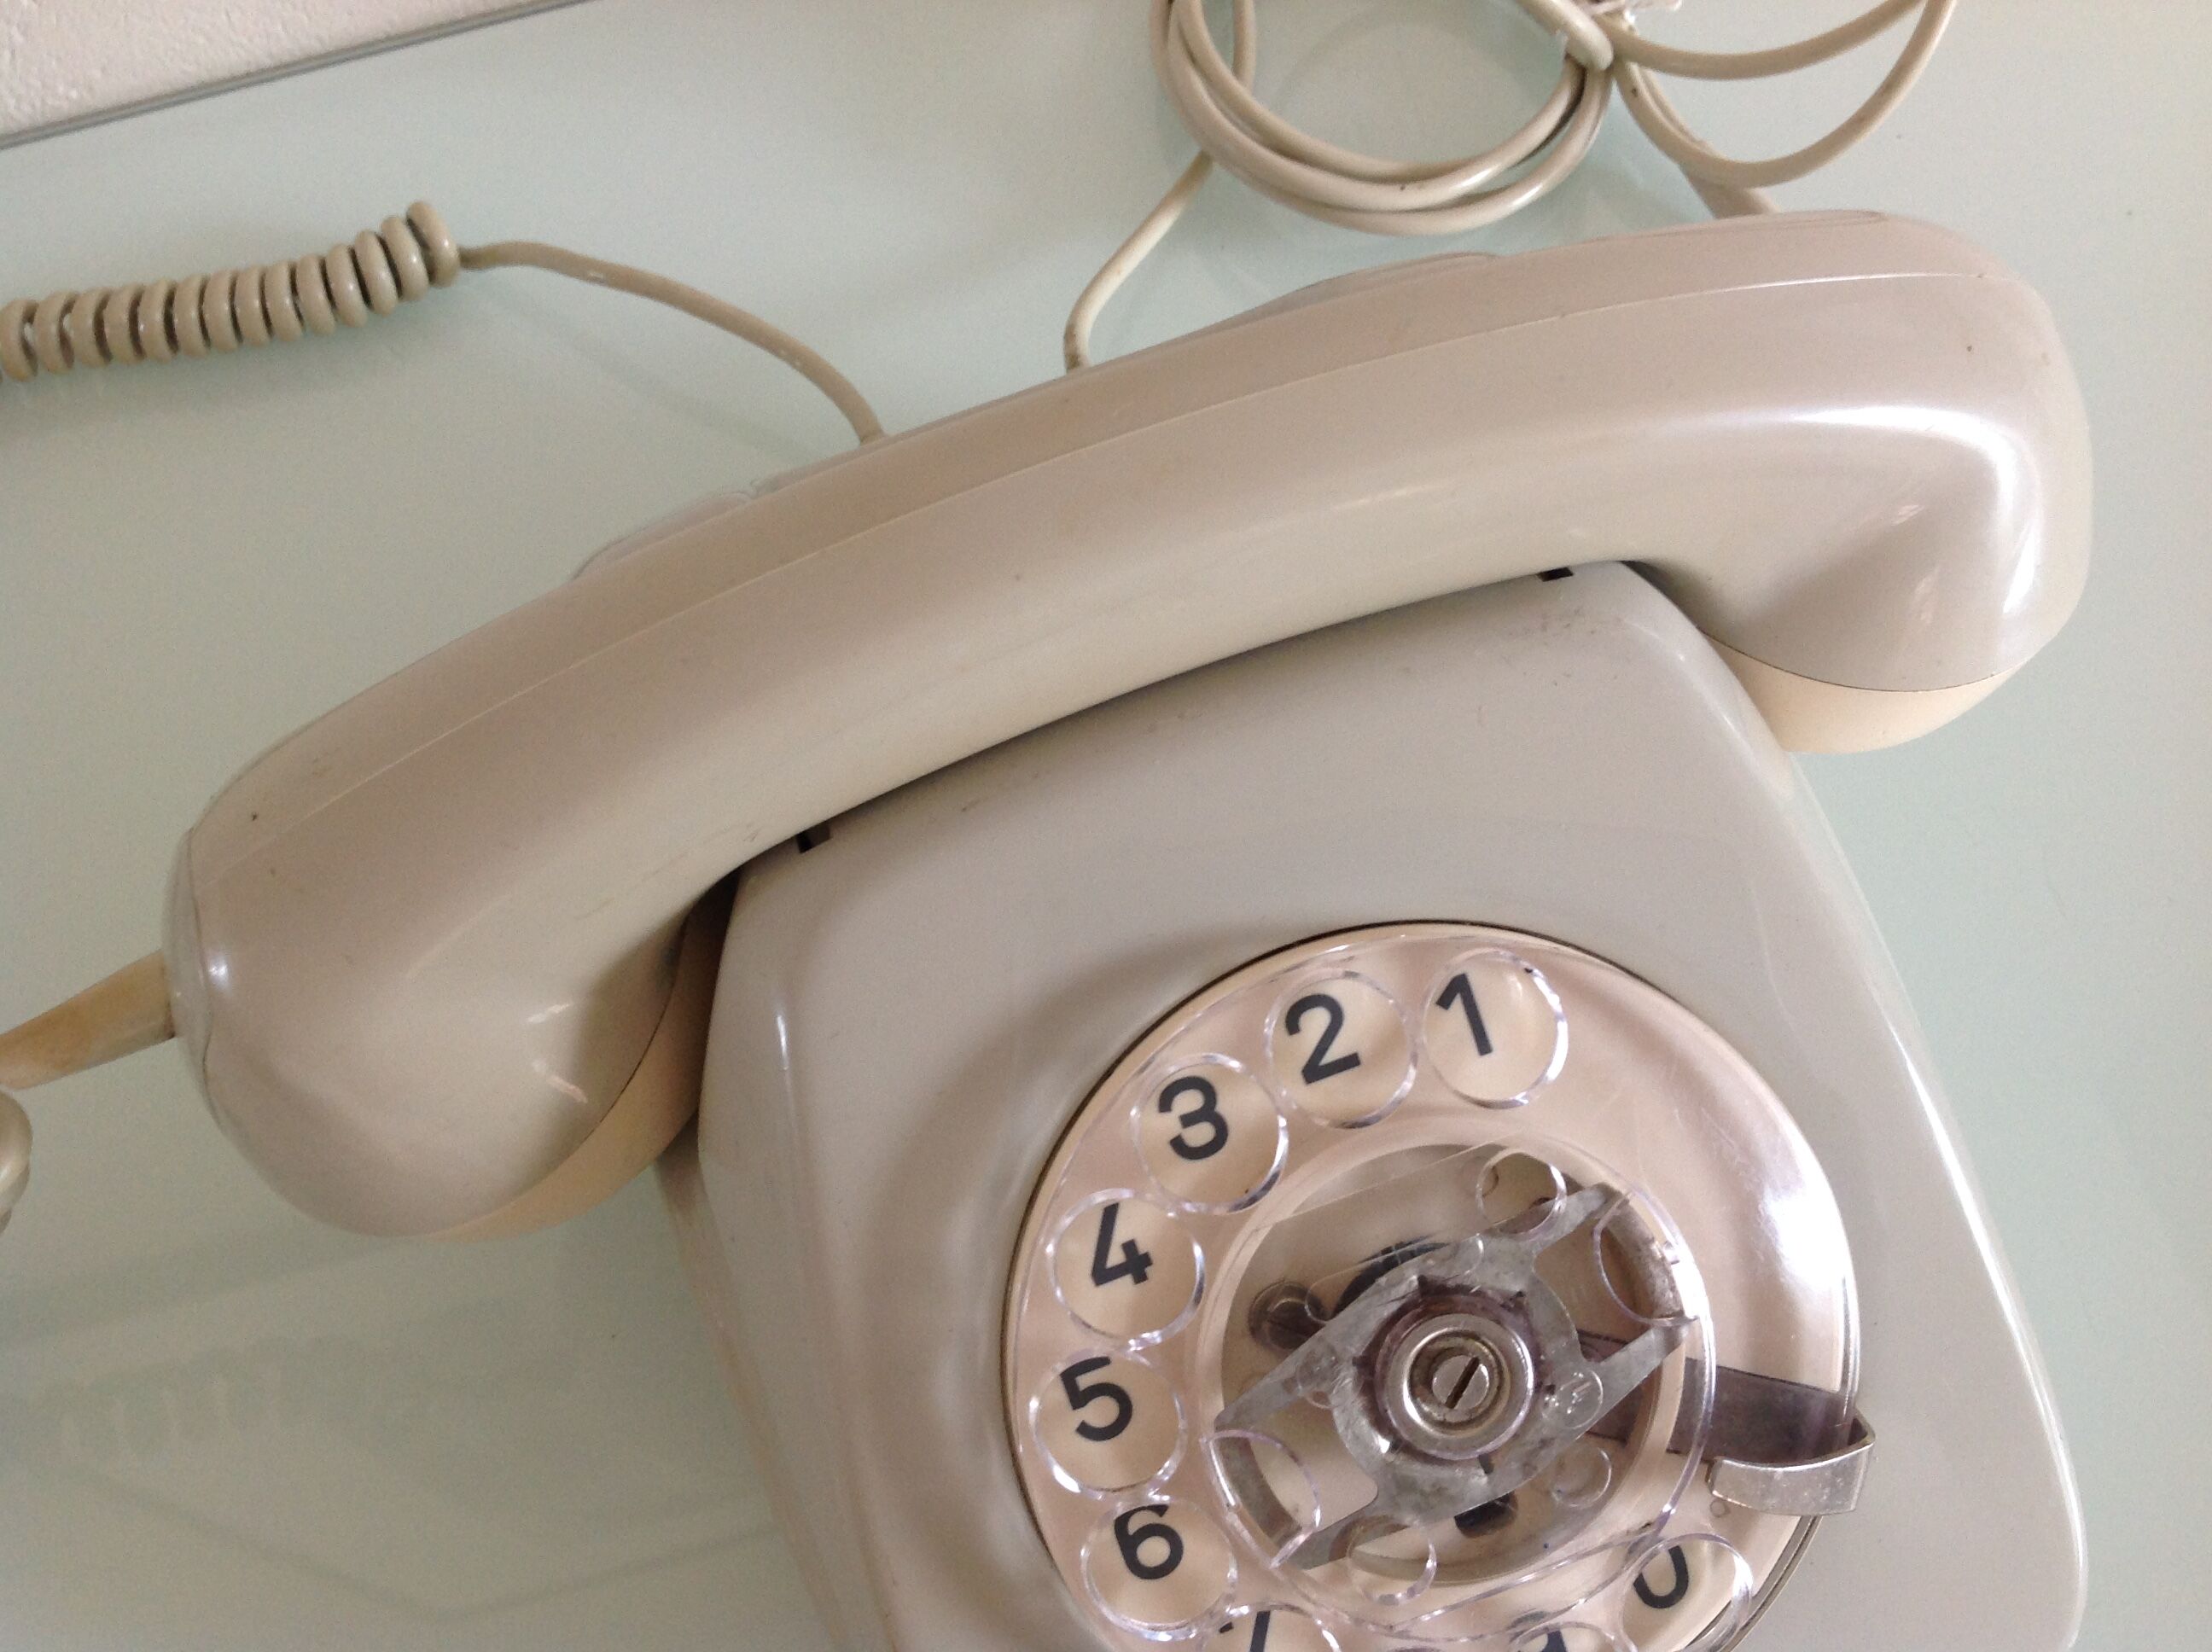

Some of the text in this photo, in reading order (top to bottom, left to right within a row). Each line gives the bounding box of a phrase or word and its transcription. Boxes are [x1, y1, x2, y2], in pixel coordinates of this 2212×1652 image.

[1284, 993, 1361, 1085] 2
[1435, 973, 1494, 1056] 1
[1158, 1075, 1229, 1160] 3
[1091, 1203, 1153, 1287] 4
[1060, 1356, 1133, 1442] 5
[1114, 1504, 1184, 1580] 6
